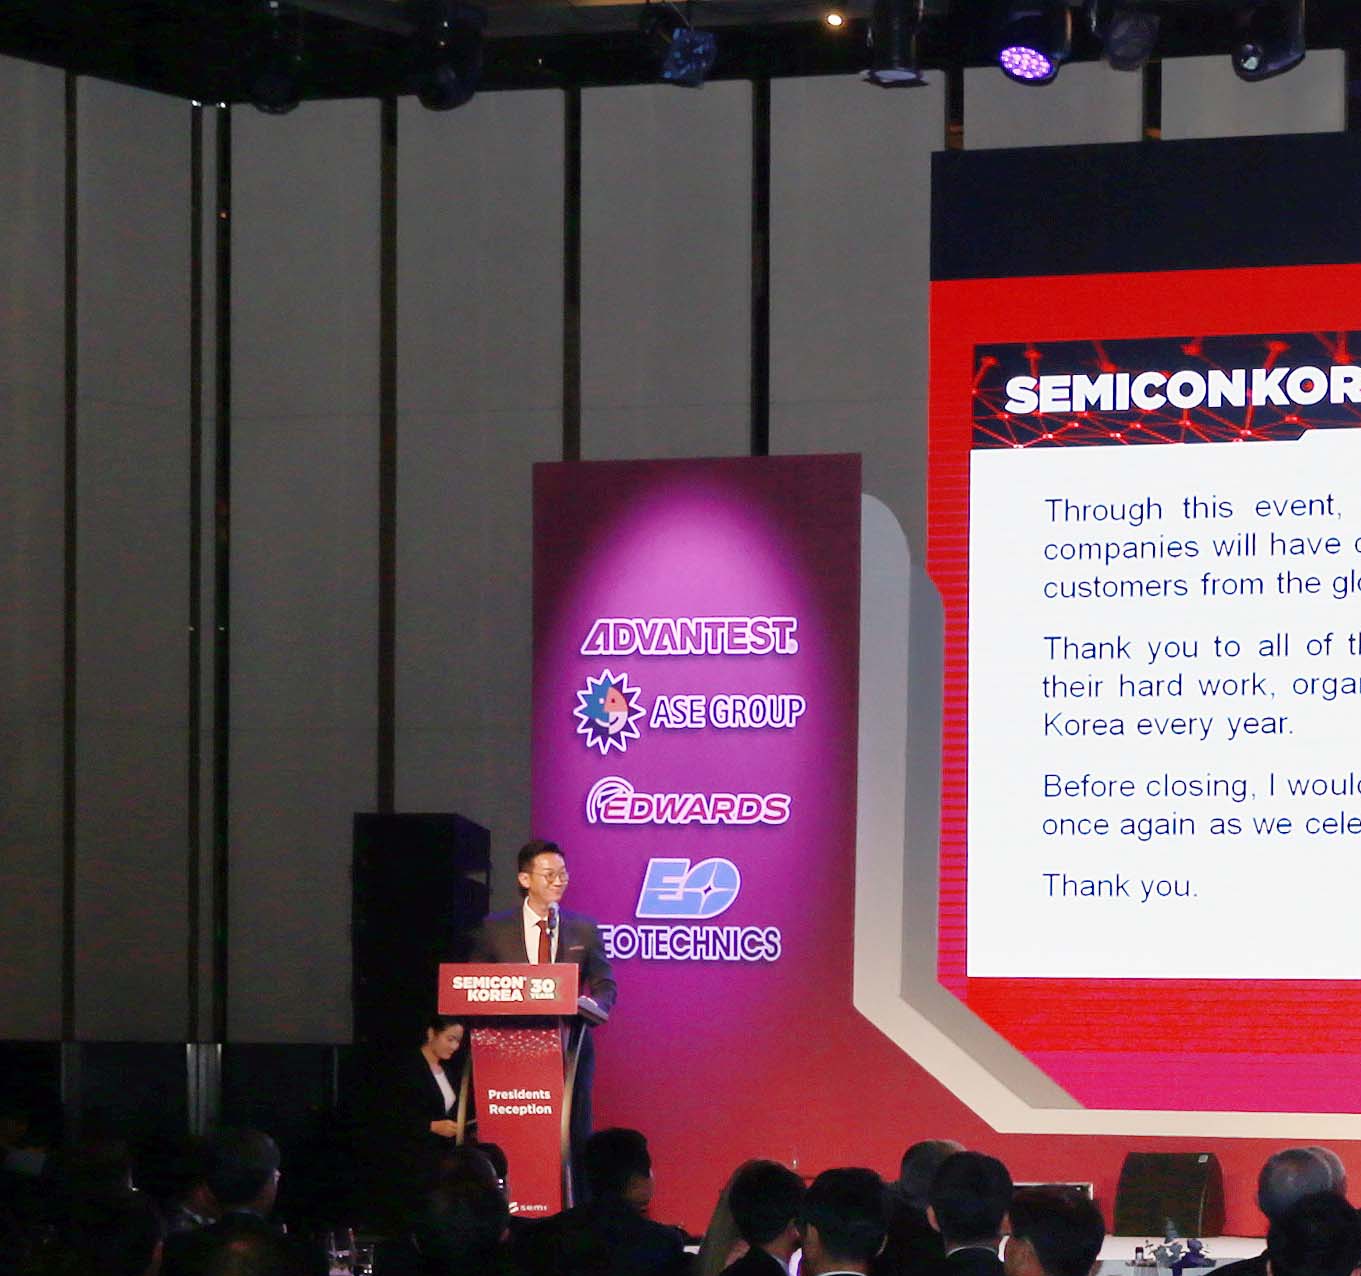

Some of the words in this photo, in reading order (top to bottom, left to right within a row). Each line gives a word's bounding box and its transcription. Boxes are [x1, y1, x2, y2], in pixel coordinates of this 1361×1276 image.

[1044, 497, 1162, 527] Through
[1183, 495, 1233, 519] this
[1256, 494, 1341, 519] event,
[1044, 534, 1199, 566] companies
[1213, 532, 1255, 557] will
[1271, 532, 1341, 556] have
[1044, 576, 1188, 598] customers
[1200, 572, 1263, 596] from
[1277, 570, 1321, 594] the
[1043, 635, 1131, 660] Thank
[1148, 641, 1197, 665] you
[1214, 635, 1240, 657] to
[1259, 633, 1288, 657] all
[1307, 632, 1334, 656] of
[1042, 674, 1103, 698] their
[1120, 673, 1182, 697] hard
[1199, 672, 1275, 699] work,
[652, 696, 706, 727] ASE
[711, 696, 805, 727] GROUP
[1045, 712, 1124, 736] Korea
[1137, 717, 1213, 741] every
[1228, 717, 1293, 741] year.
[1044, 774, 1135, 797] Before
[1146, 773, 1255, 803] closing,
[1269, 773, 1275, 796] I
[601, 793, 791, 823] EDWARDS
[1043, 818, 1109, 836] once
[1121, 811, 1194, 841] again
[1210, 818, 1242, 835] as
[1253, 817, 1292, 835] we
[1042, 873, 1130, 897] Thank
[1141, 880, 1197, 903] you.
[467, 989, 524, 1002] KOREA
[529, 979, 556, 993] 30
[488, 1089, 551, 1100] Presidents
[489, 1104, 552, 1116] Reception
